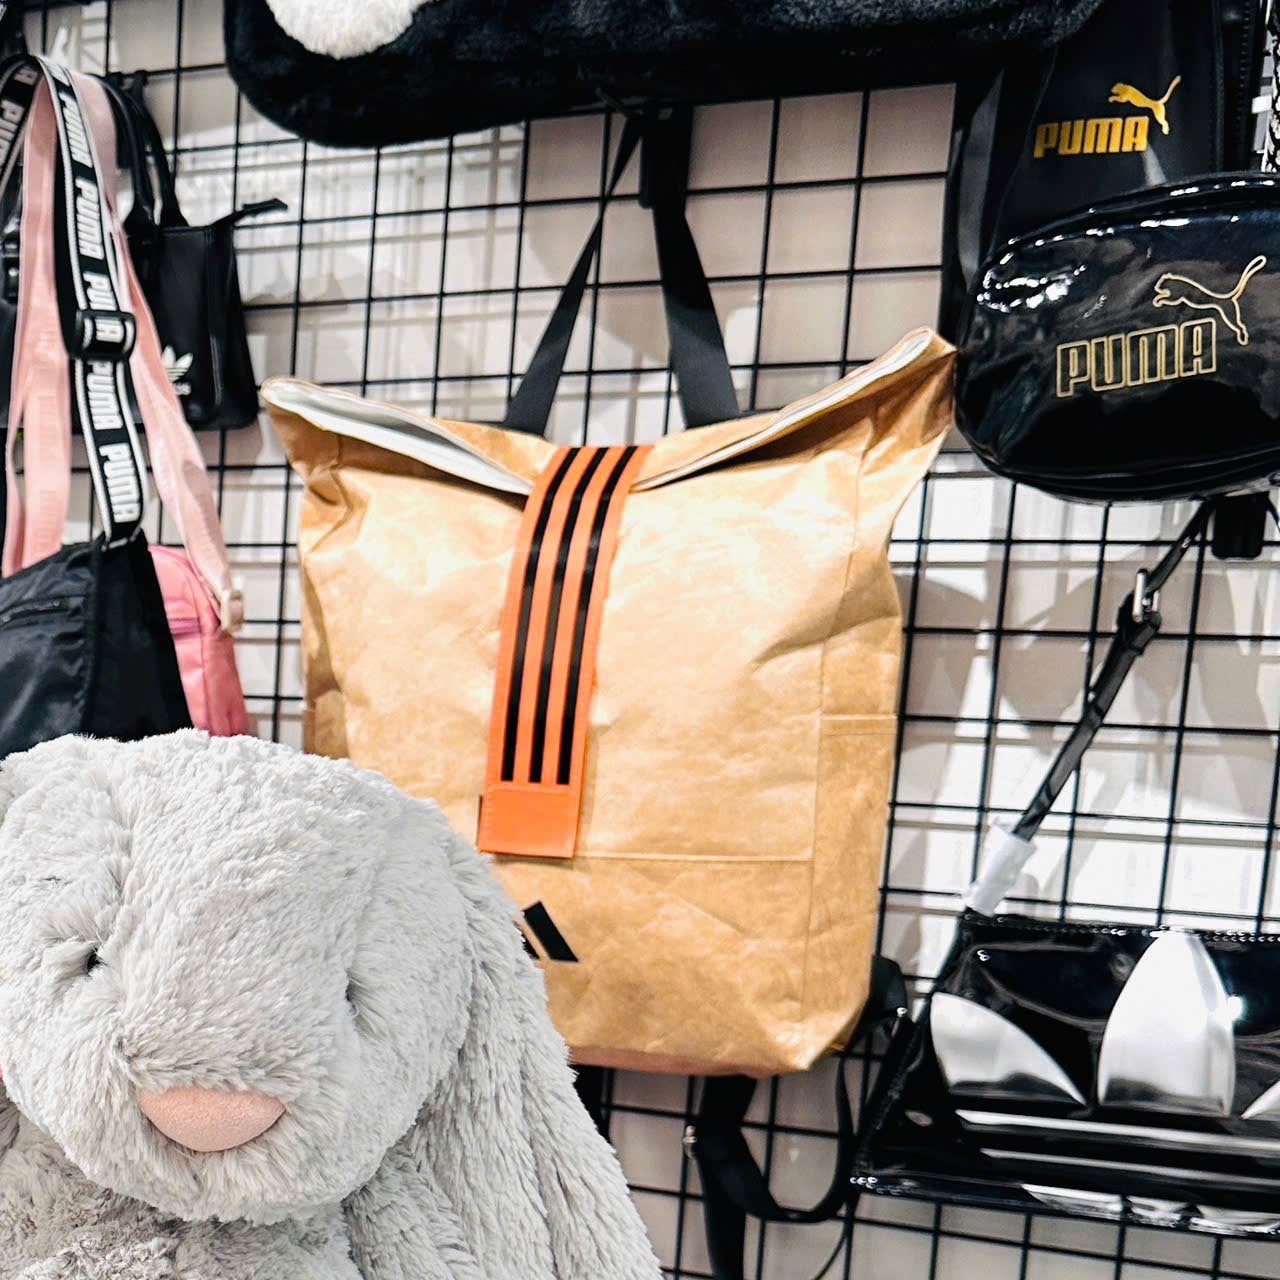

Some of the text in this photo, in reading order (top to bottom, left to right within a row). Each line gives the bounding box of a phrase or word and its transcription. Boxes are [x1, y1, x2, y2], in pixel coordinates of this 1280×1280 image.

[58, 91, 94, 168] PUMA
[1033, 116, 1150, 158] PUMA
[75, 176, 105, 260] PUMA
[86, 360, 123, 430] PUMA
[1056, 317, 1217, 398] PUMA
[98, 443, 141, 523] PUMA
